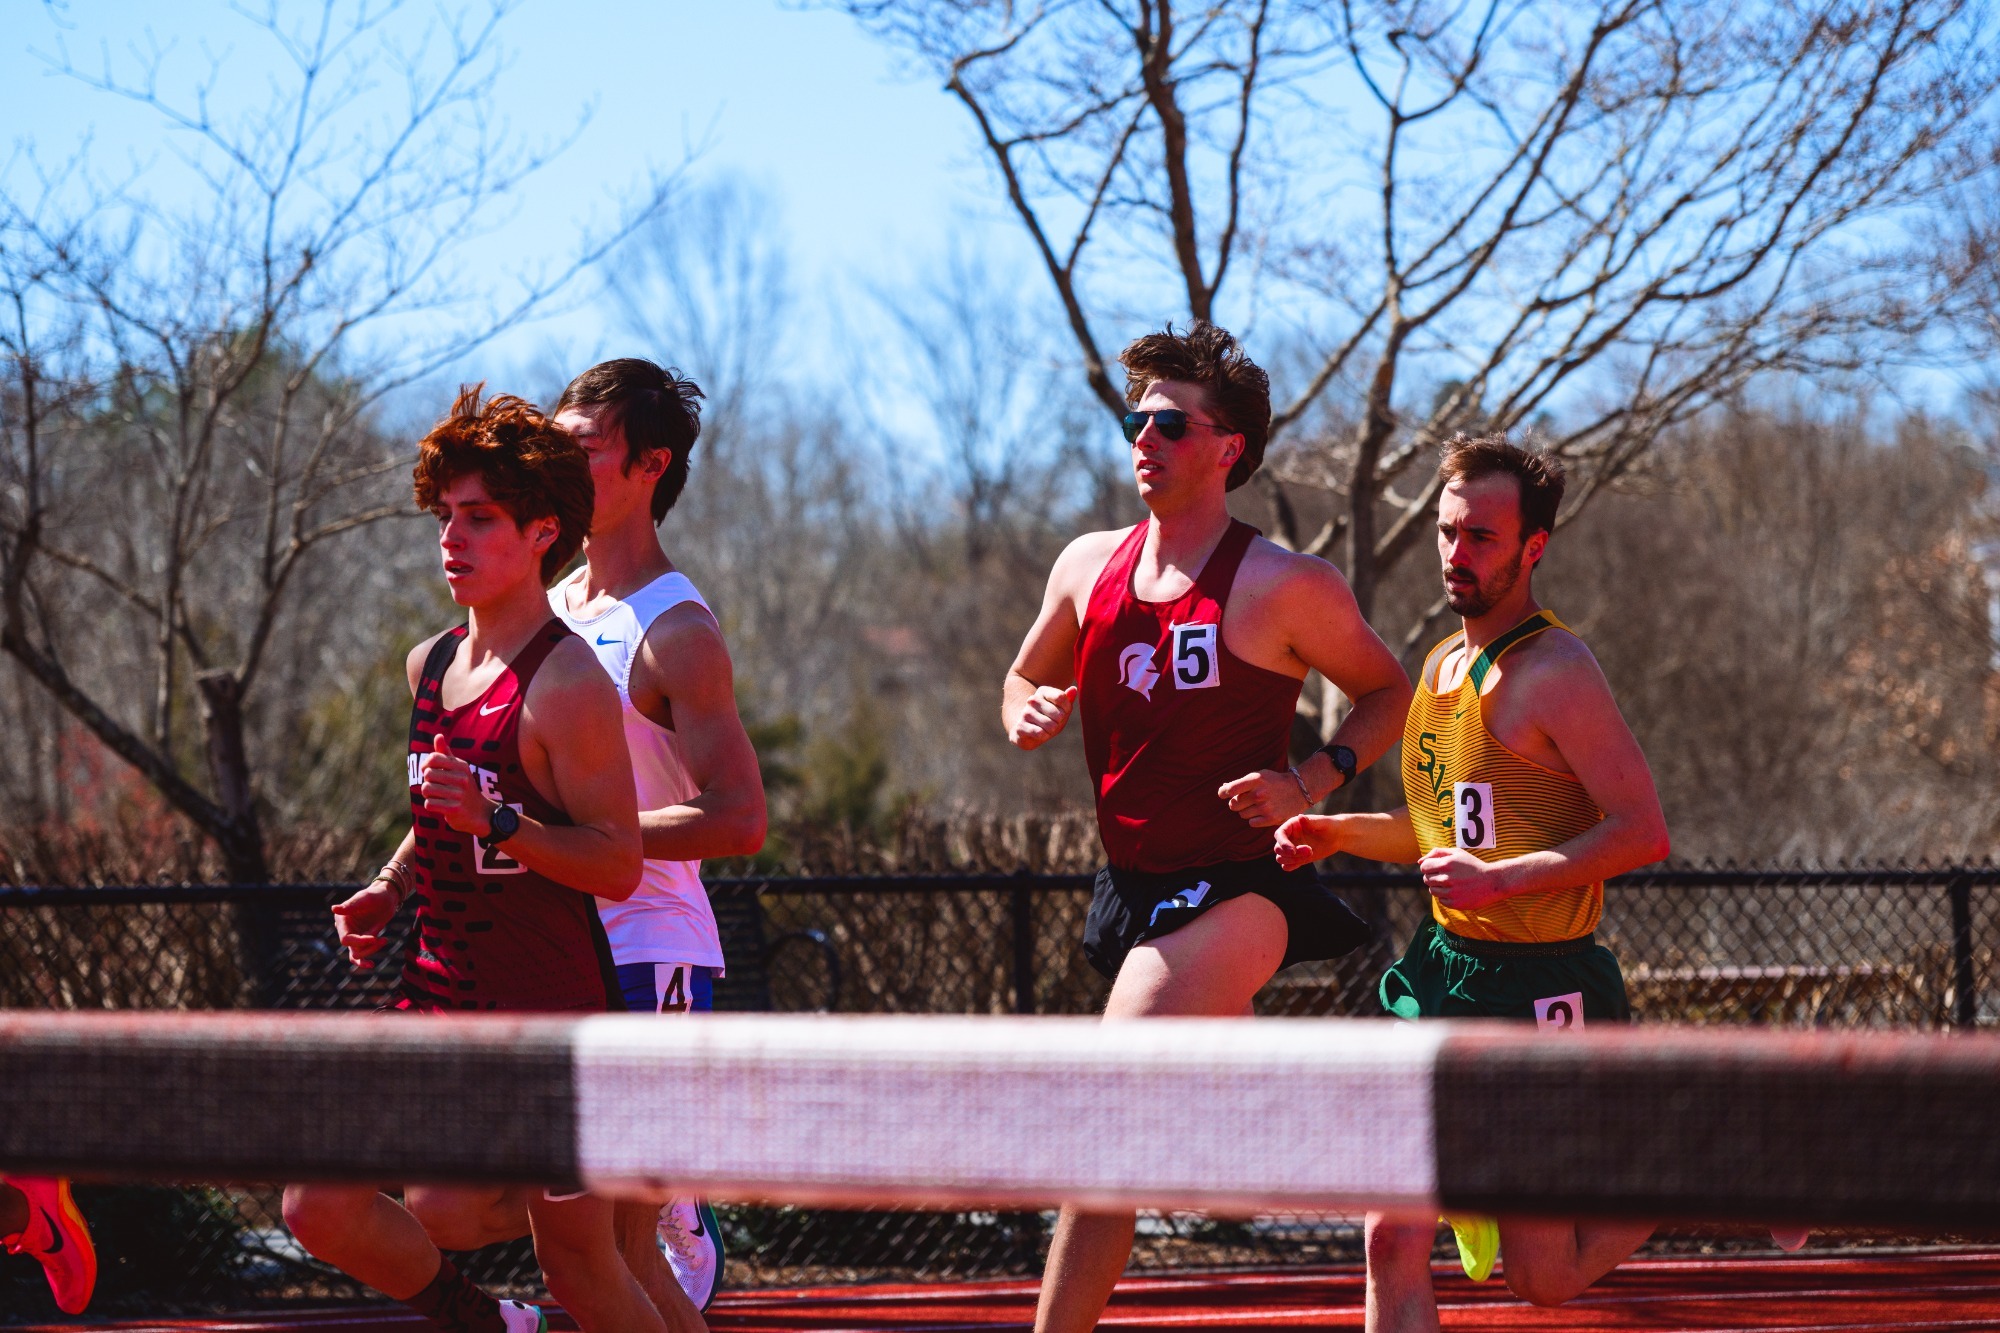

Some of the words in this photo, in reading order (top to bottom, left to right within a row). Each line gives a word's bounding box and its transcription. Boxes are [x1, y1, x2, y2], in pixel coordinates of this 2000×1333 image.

[1177, 628, 1210, 685] 5
[1460, 787, 1485, 848] 3
[661, 966, 688, 1015] 4
